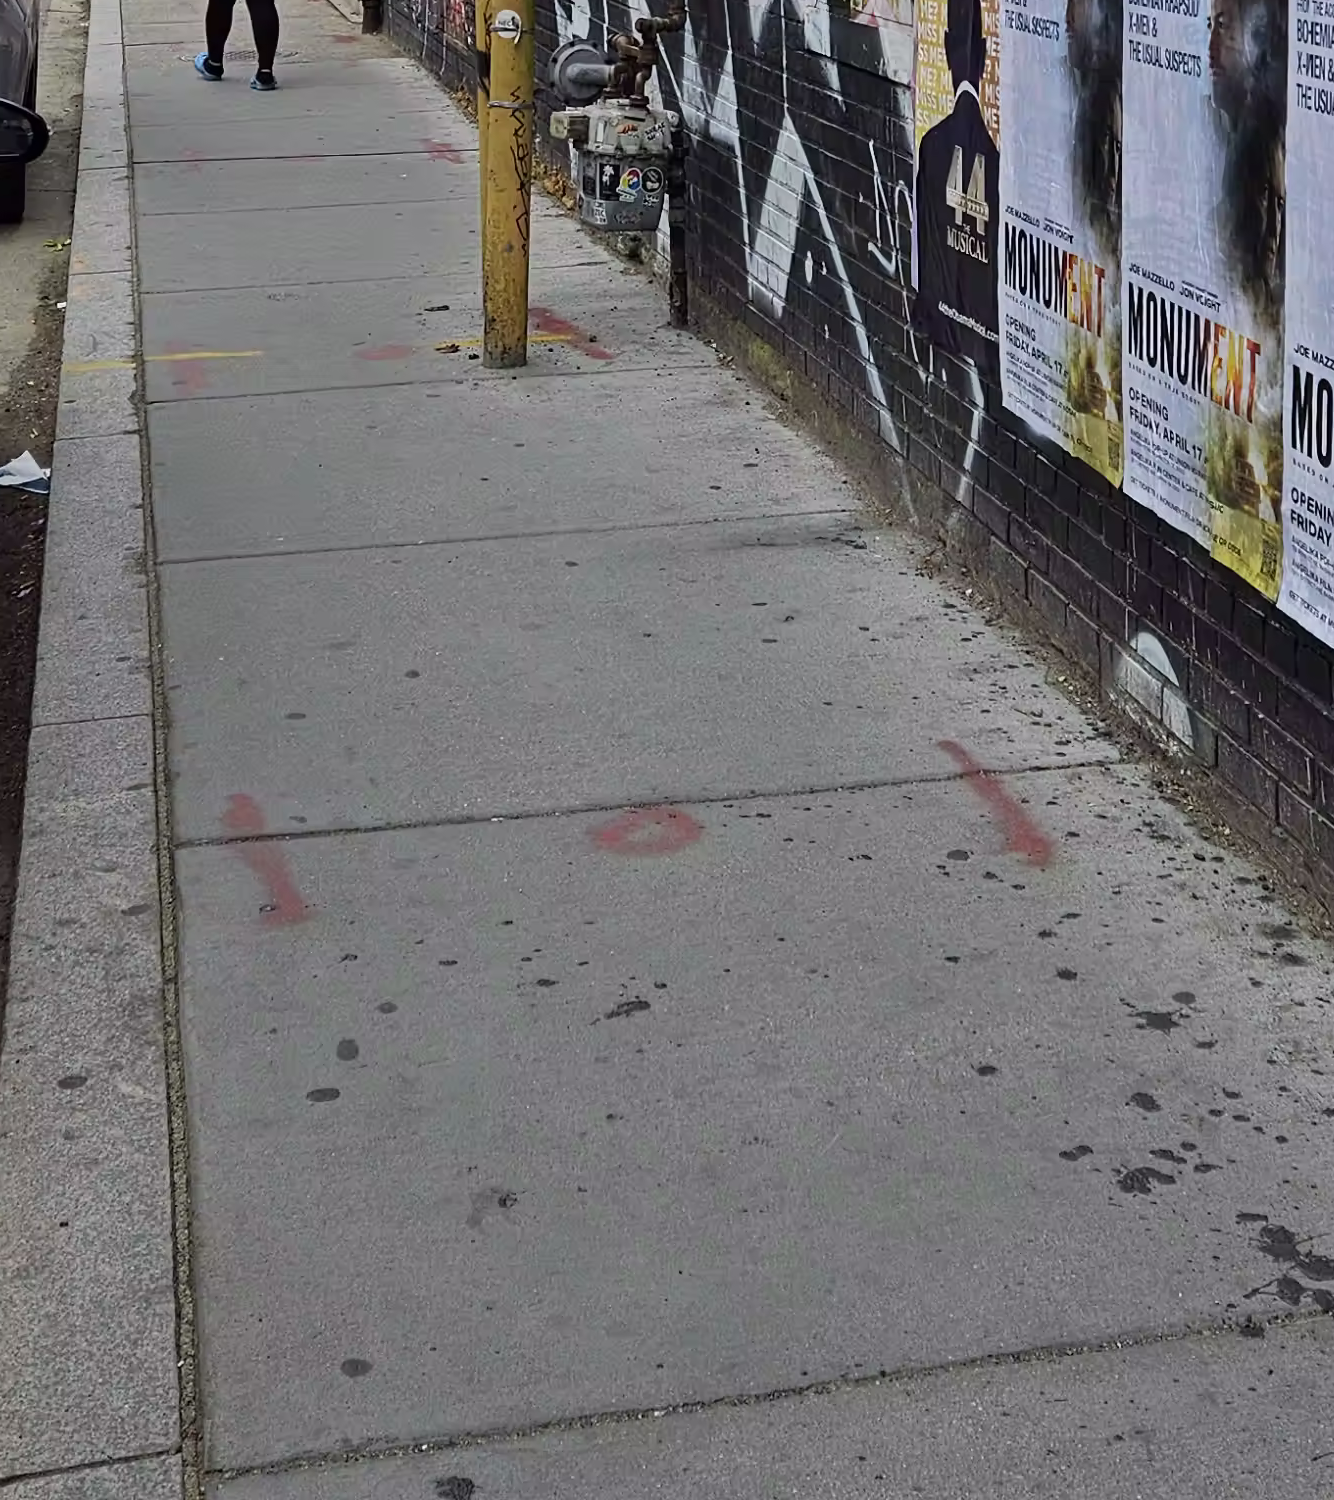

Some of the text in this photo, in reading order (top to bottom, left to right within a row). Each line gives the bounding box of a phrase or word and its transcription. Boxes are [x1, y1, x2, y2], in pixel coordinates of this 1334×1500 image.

[946, 224, 988, 263] MUSICAL
[1005, 221, 1105, 337] MONUMENT
[1129, 281, 1260, 424] MONUMENT
